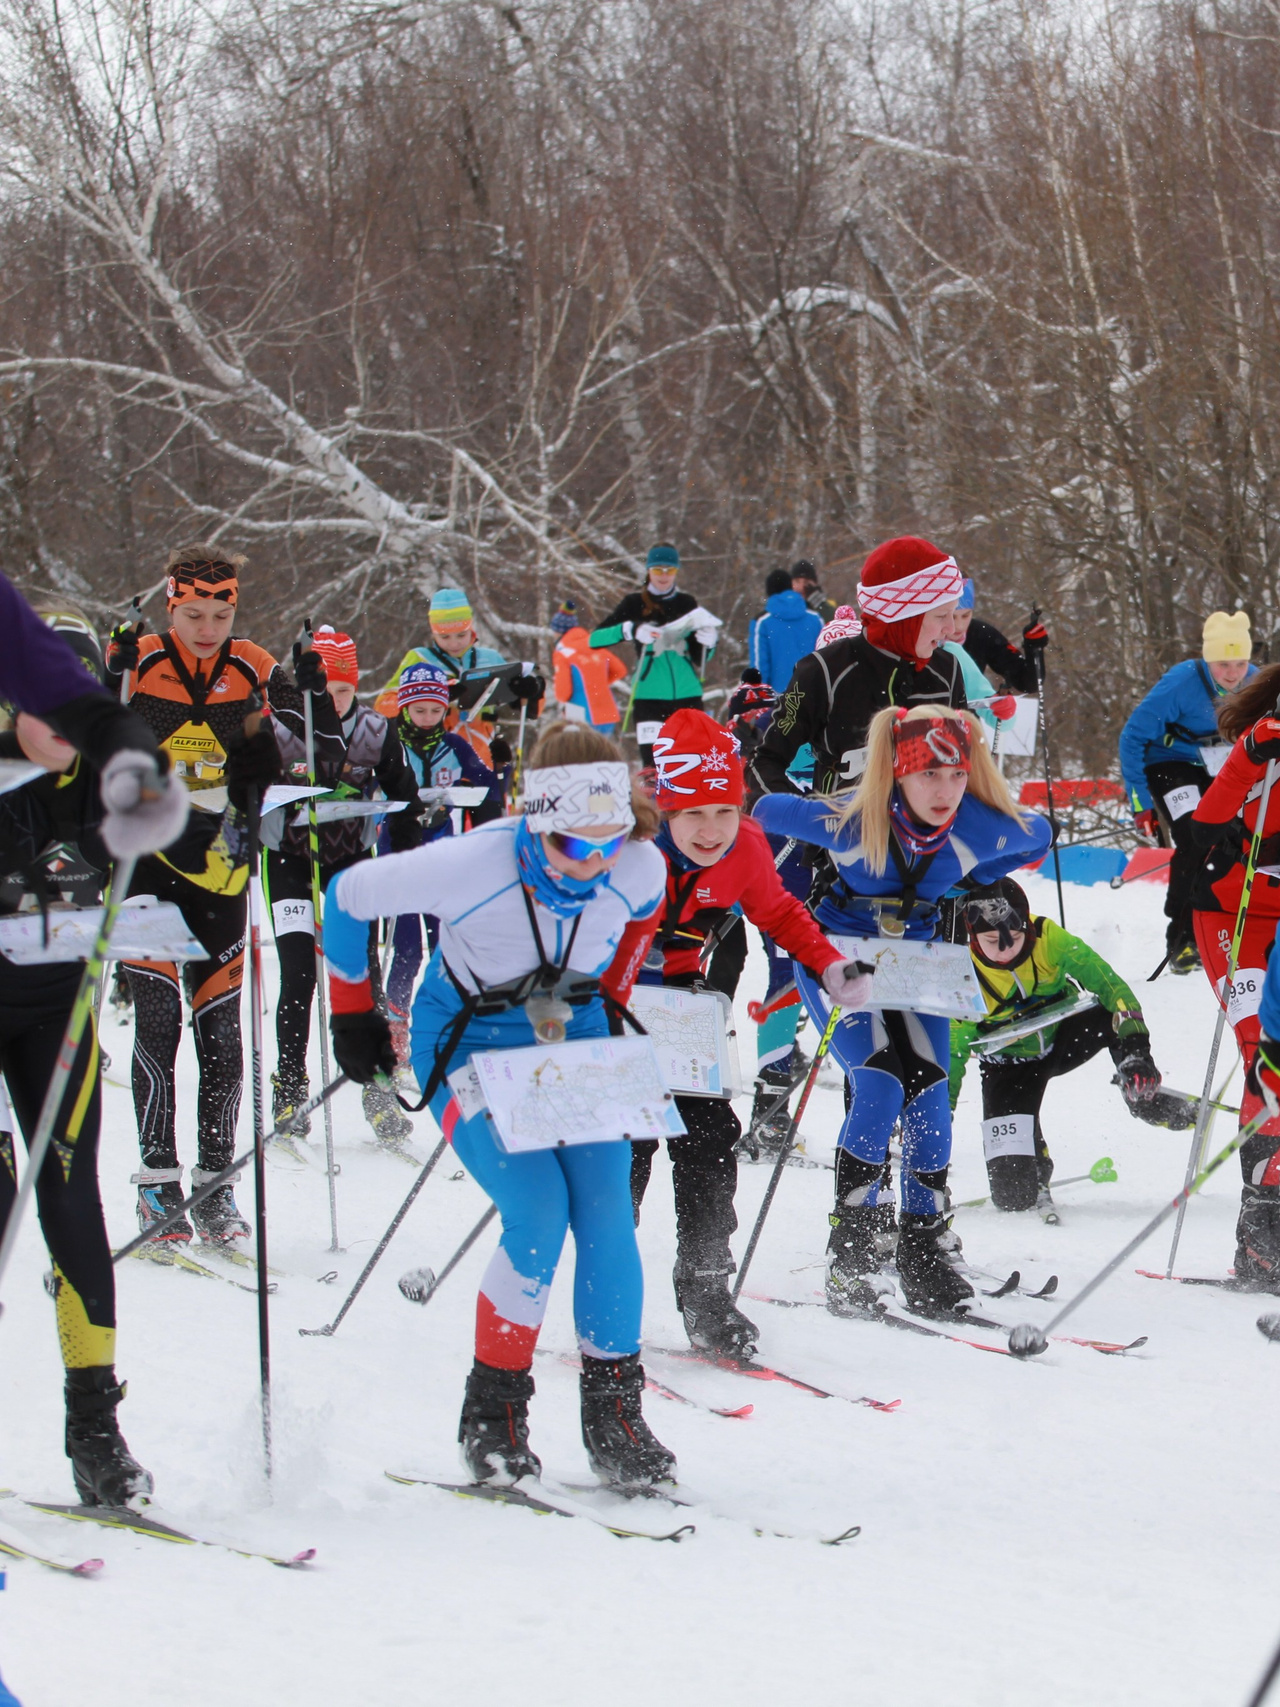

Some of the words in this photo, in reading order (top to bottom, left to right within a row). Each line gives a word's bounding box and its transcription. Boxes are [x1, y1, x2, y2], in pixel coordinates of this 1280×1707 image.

[173, 739, 214, 749] ALFAVIT
[1171, 791, 1190, 804] 963
[283, 904, 307, 917] 947
[1229, 979, 1257, 999] 936
[252, 1048, 264, 1137] NORDWAY
[991, 1122, 1018, 1138] 935
